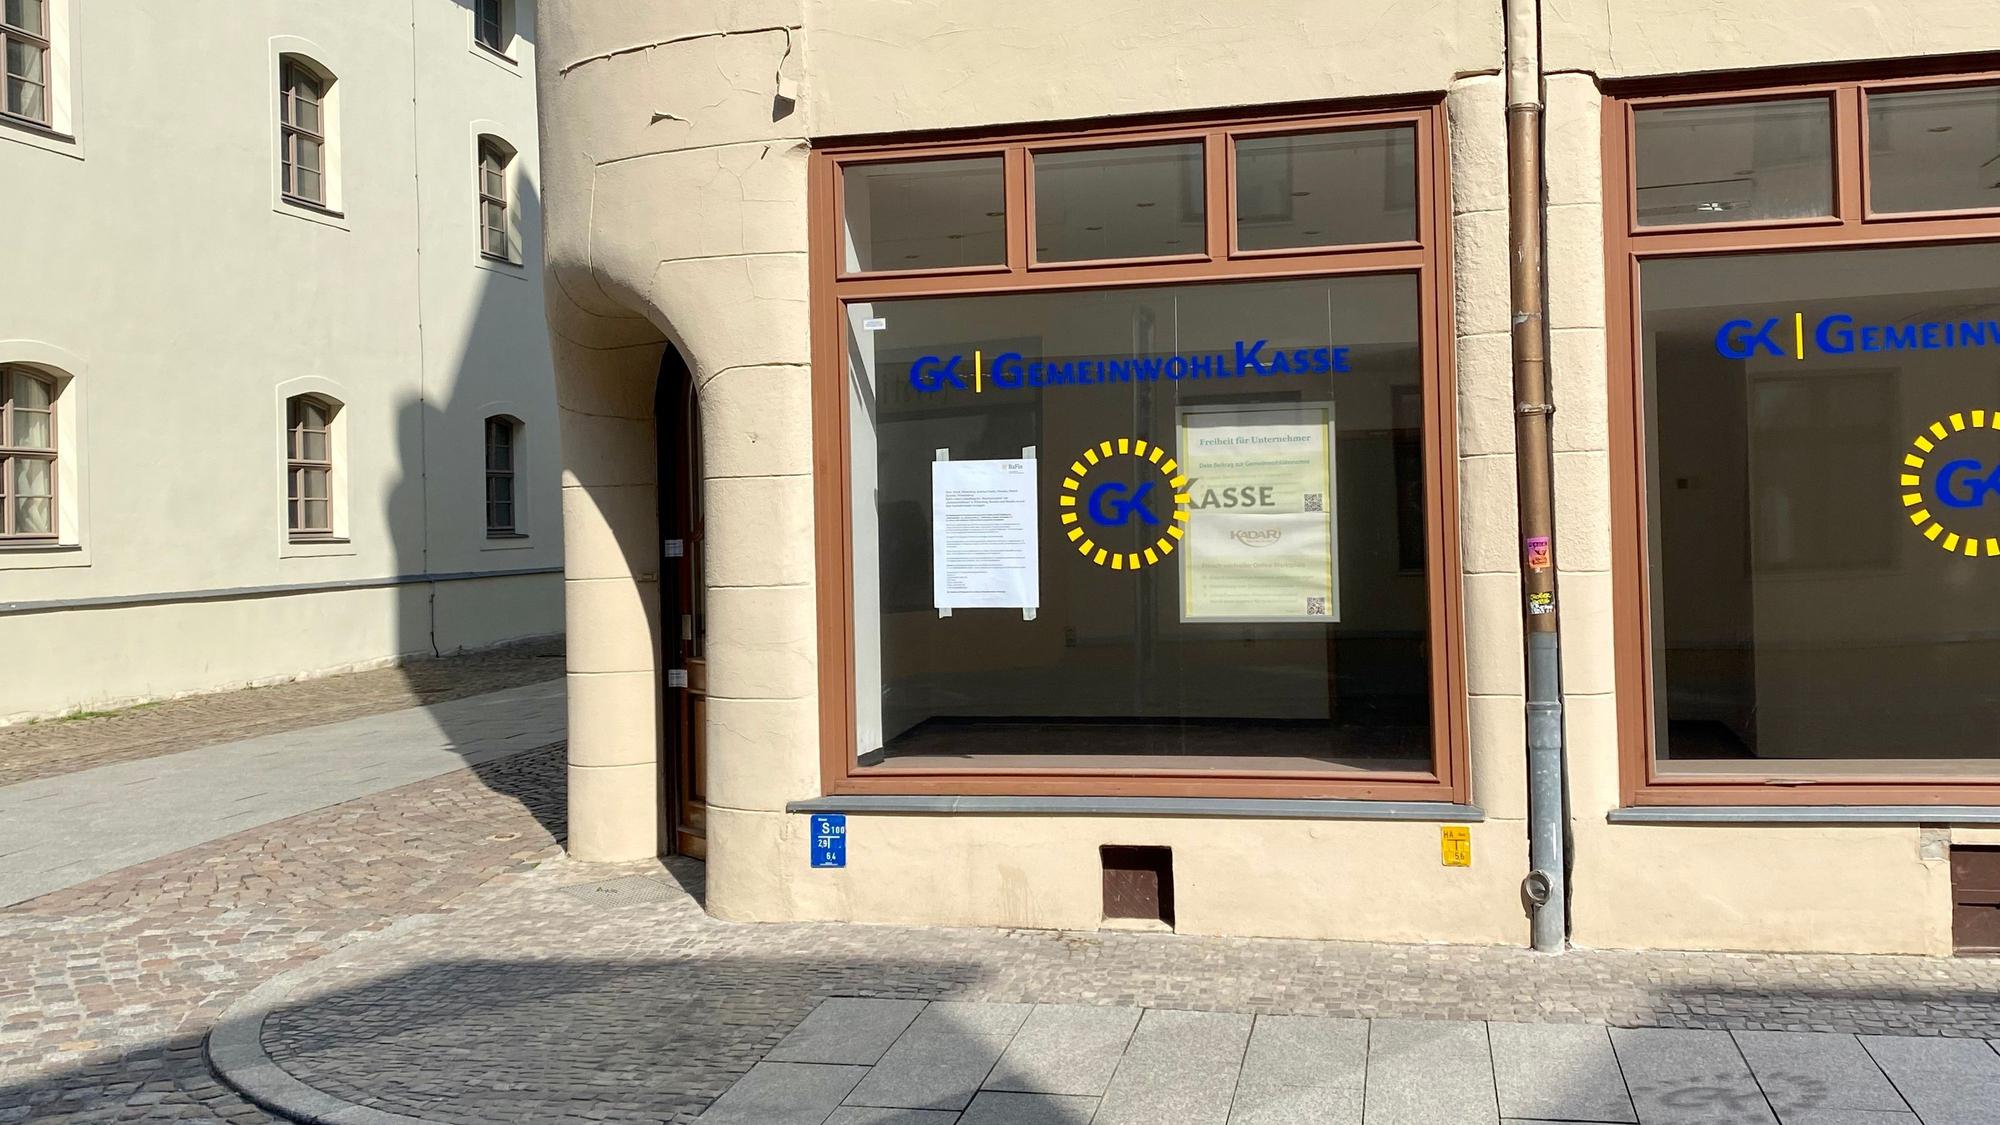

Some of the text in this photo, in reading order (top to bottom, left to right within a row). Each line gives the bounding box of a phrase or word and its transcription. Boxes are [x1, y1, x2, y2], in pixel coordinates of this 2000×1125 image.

[1715, 317, 1786, 360] GK
[909, 355, 968, 392] GK
[991, 339, 1351, 389] GEMEINWOHLKASSE
[1199, 435, 1311, 446] Freiheit für Unternehmer
[1088, 481, 1160, 527] GK
[822, 822, 845, 834] S 100
